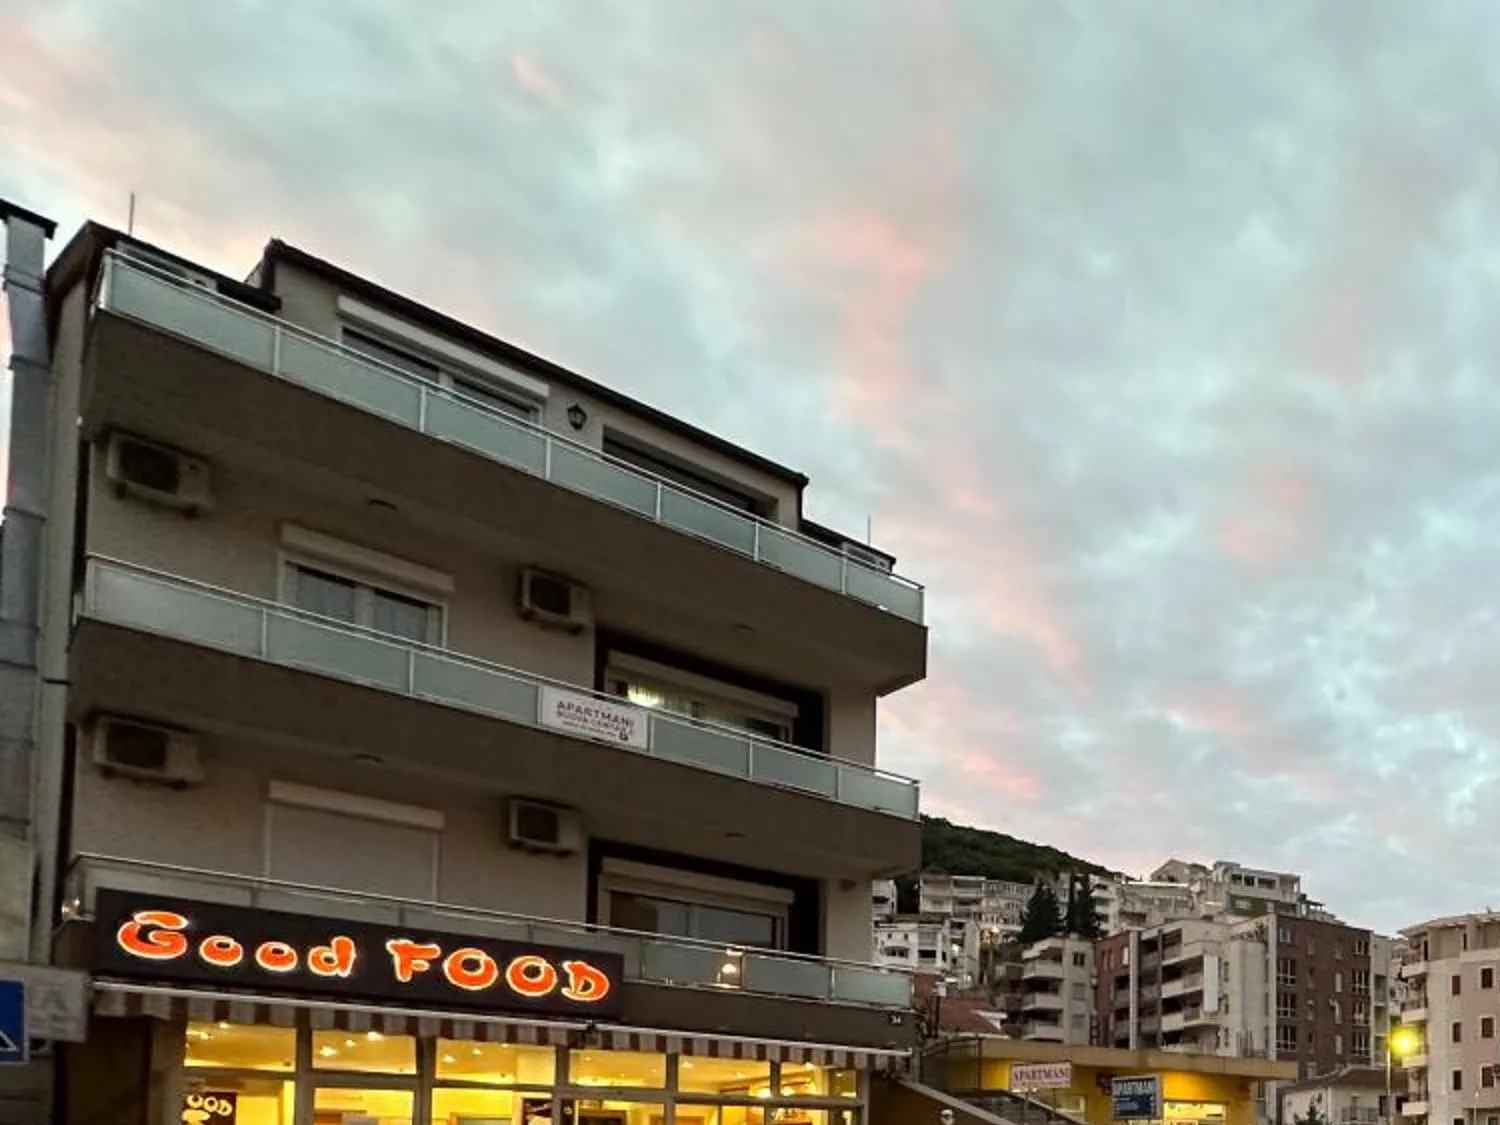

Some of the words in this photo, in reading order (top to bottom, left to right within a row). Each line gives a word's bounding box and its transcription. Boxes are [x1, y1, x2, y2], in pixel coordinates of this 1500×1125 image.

[117, 910, 356, 978] Good
[386, 938, 611, 1002] FOOD
[186, 1094, 233, 1117] OOD
